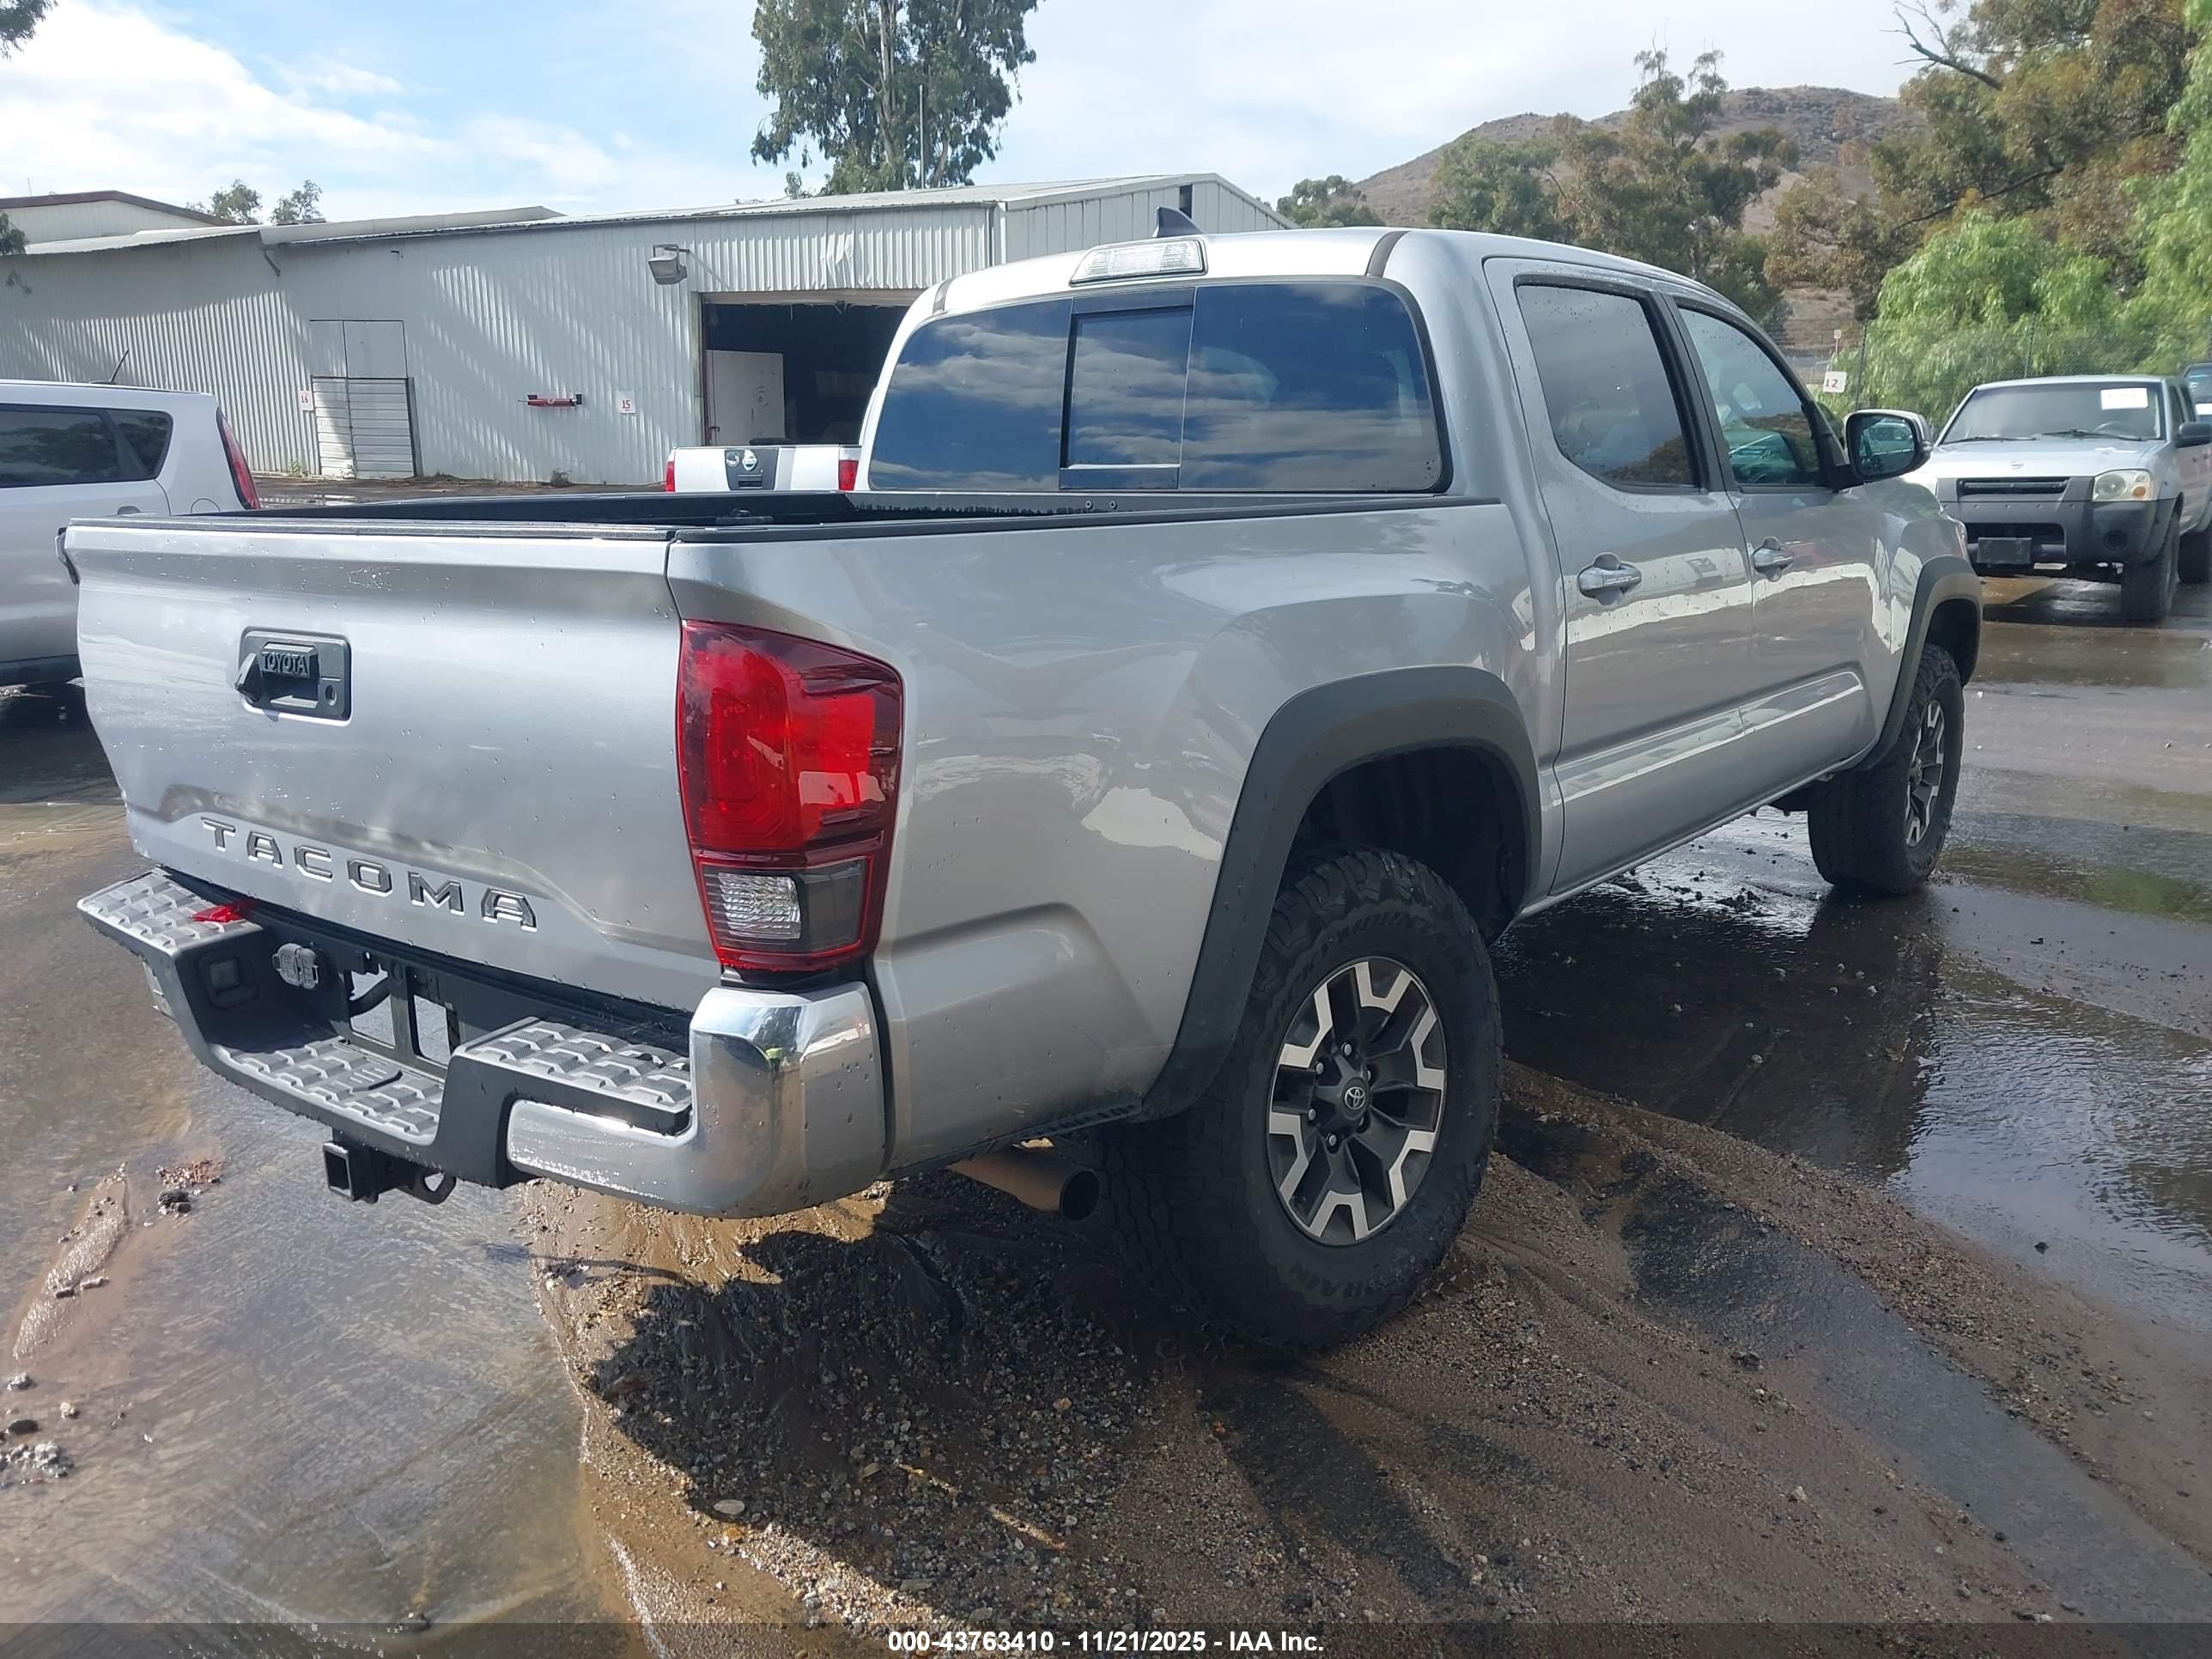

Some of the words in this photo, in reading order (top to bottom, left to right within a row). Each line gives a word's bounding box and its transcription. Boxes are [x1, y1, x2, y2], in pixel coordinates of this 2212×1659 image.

[622, 399, 631, 409] 15
[261, 652, 308, 676] TOYOTA
[200, 817, 538, 933] TACOMA
